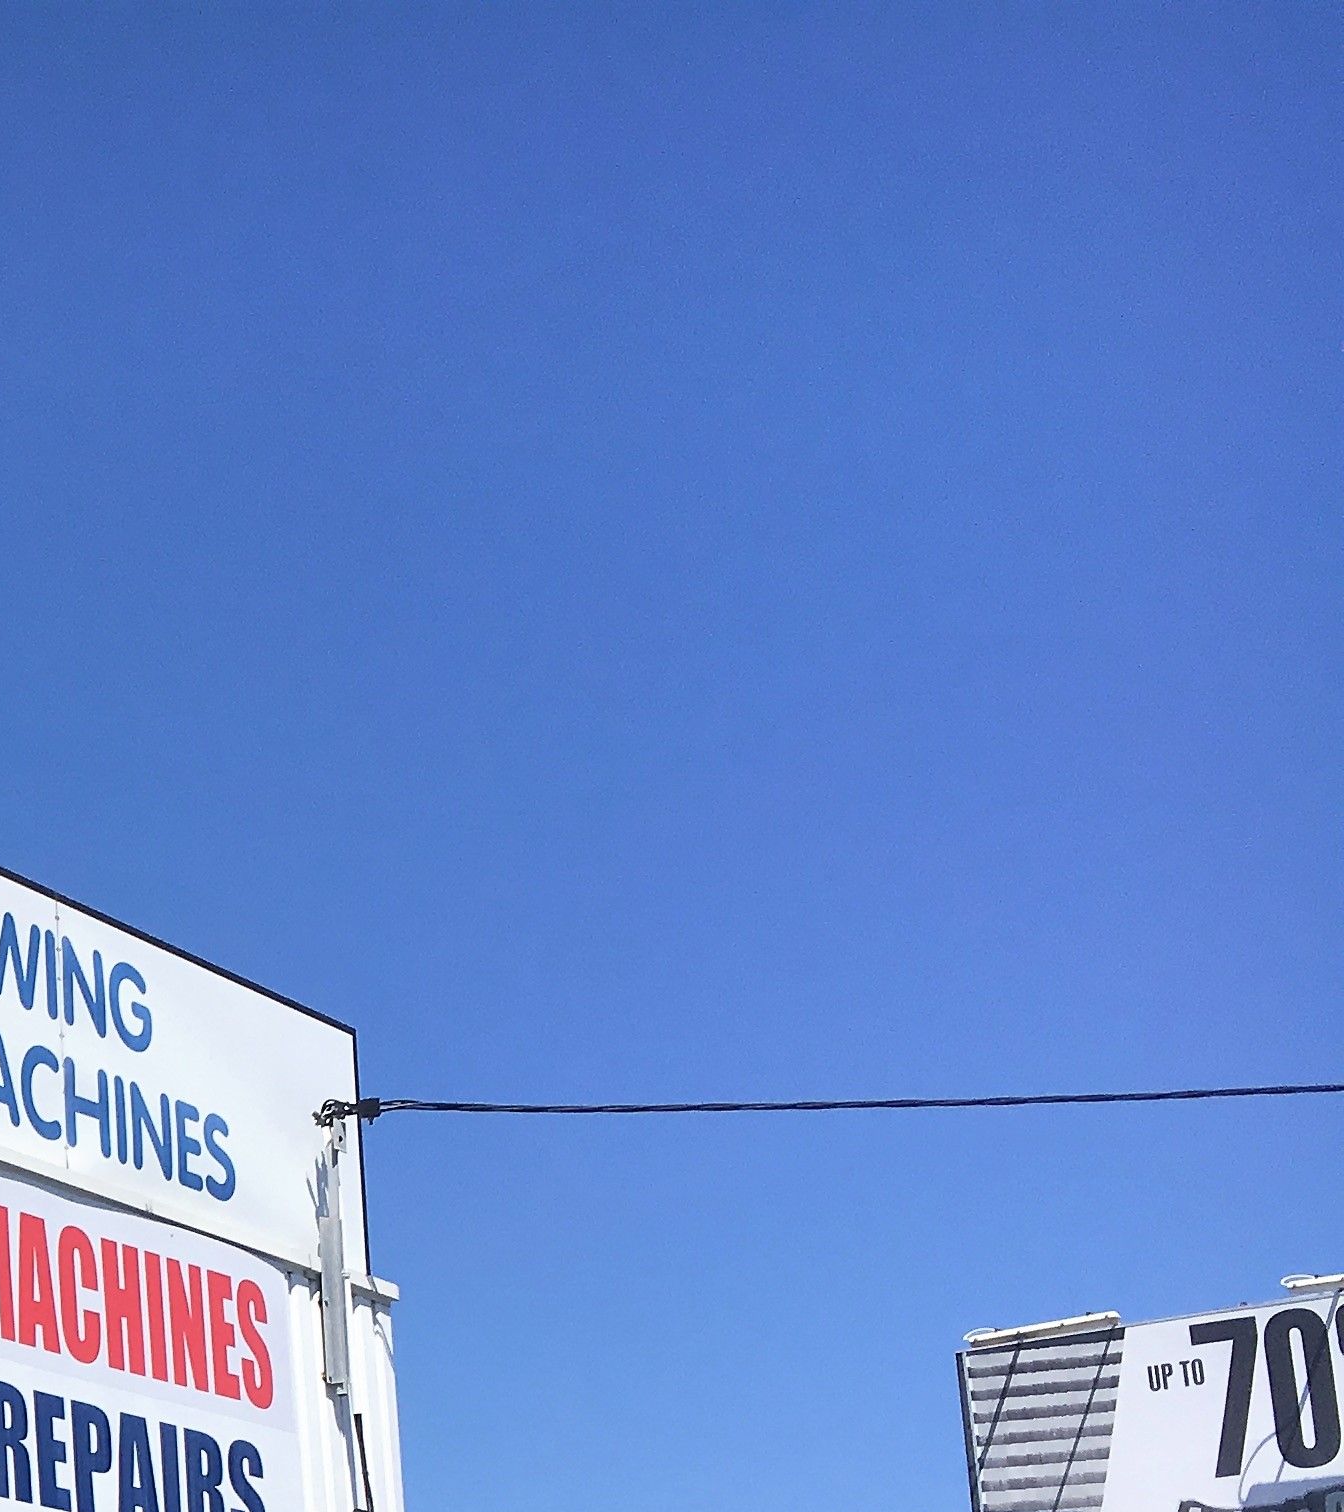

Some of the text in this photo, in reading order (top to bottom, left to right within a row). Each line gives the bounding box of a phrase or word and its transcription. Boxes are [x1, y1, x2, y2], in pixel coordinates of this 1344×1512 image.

[1147, 1357, 1205, 1392] UP TO
[1189, 1307, 1344, 1479] 70
